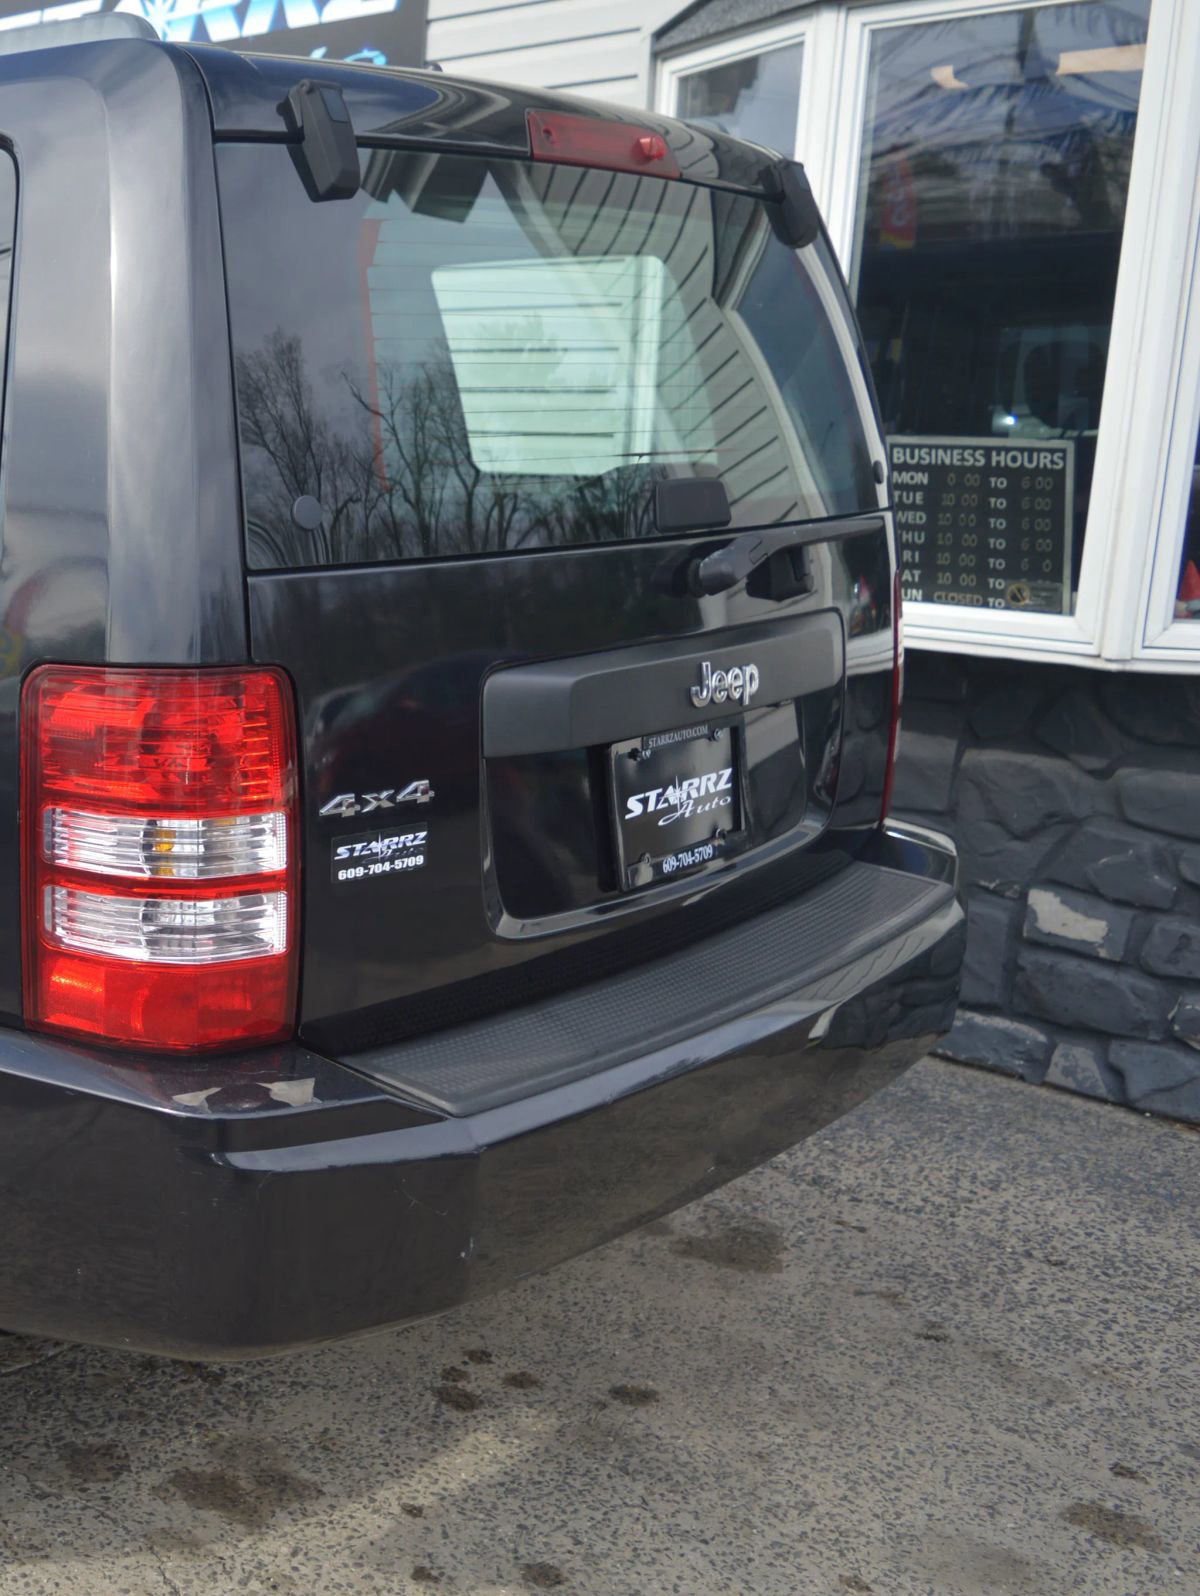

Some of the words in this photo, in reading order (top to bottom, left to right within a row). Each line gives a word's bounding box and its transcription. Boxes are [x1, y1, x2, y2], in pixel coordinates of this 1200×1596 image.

[892, 447, 986, 467] BUSINESS
[991, 450, 1065, 470] HOURS
[892, 471, 929, 485] MON
[963, 473, 980, 487] 00
[989, 477, 1008, 489] TO
[1035, 476, 1053, 490] 00
[893, 491, 924, 505] TUE
[961, 493, 978, 507] 00
[988, 497, 1007, 510] TO
[1034, 497, 1052, 511] 00
[938, 512, 952, 526] 10
[988, 518, 1007, 530] TO
[1034, 518, 1052, 531] 00
[899, 530, 926, 545] HU
[937, 531, 953, 545] 10
[961, 533, 978, 547] 00
[987, 538, 1006, 550] TO
[1035, 538, 1053, 552] 00
[902, 549, 920, 564] RI
[936, 552, 951, 565] 10
[958, 552, 976, 567] 00
[987, 558, 1006, 570] TO
[901, 569, 922, 583] AT
[937, 571, 952, 585] 10
[959, 572, 977, 587] 00
[987, 578, 1006, 590] TO
[901, 587, 923, 601] UN
[933, 591, 984, 606] CLOSED
[987, 597, 1006, 609] TO
[690, 661, 760, 708] Jeep
[648, 725, 709, 749] STARRZAUTO.COM
[625, 768, 733, 820] STARRZ
[657, 796, 732, 826] Auto
[333, 831, 429, 861] STARRZ
[337, 854, 425, 881] 609-704-5709
[662, 844, 714, 874] 609-704-5709
